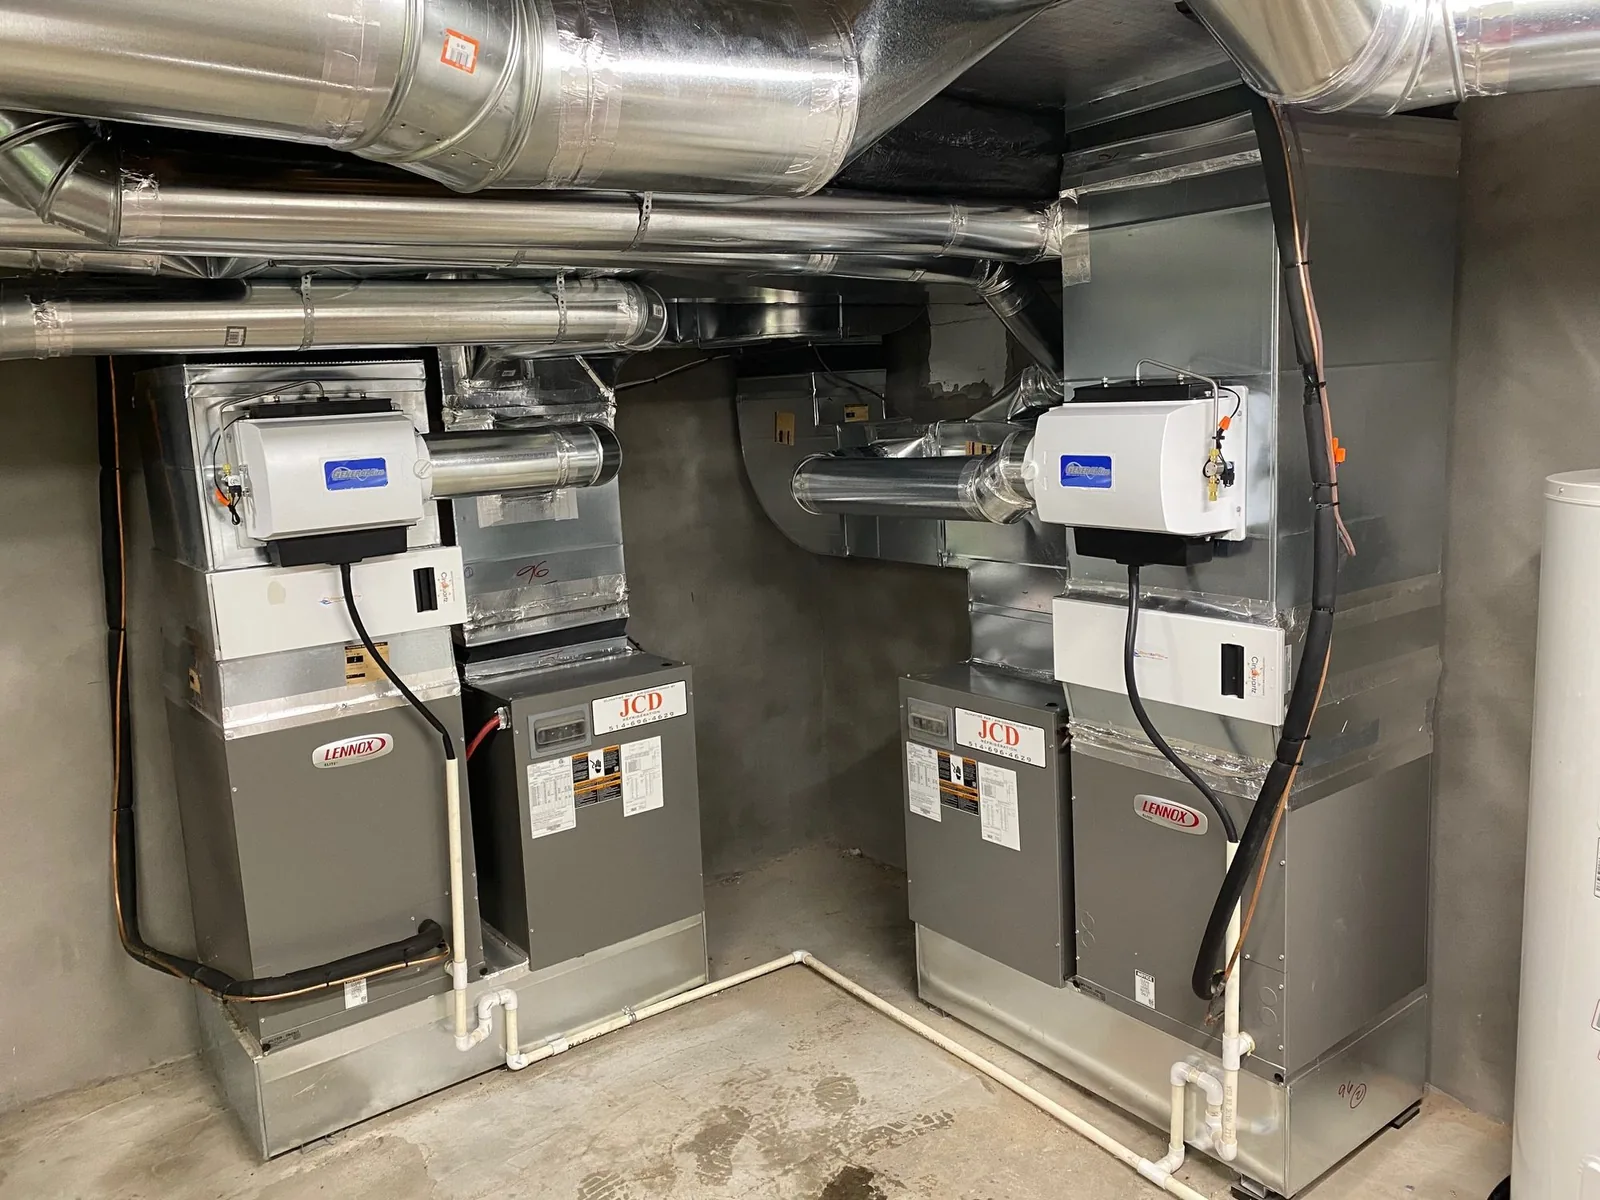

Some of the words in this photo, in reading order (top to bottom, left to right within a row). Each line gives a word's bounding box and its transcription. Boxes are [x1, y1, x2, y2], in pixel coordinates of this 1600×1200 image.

[619, 692, 663, 718] JCD
[608, 711, 674, 731] 514-696-4629
[978, 720, 1020, 746] JCD
[324, 740, 374, 761] LENNOX
[968, 741, 1032, 763] 514-696-4629
[1142, 800, 1187, 824] LENNOX
